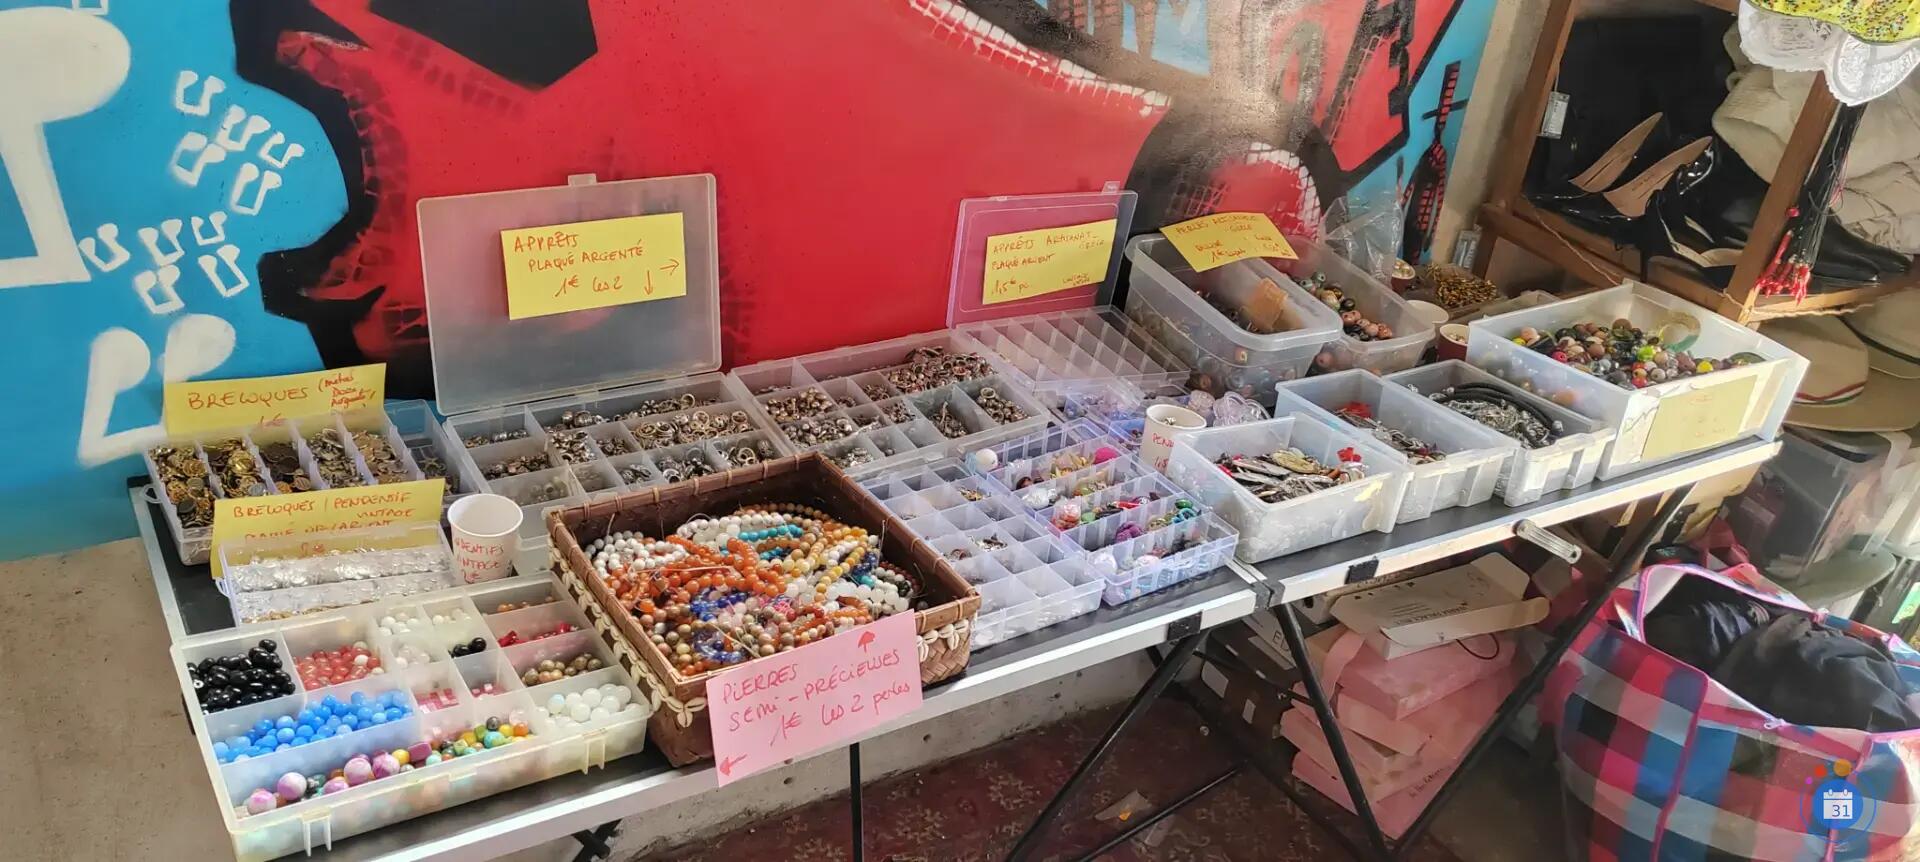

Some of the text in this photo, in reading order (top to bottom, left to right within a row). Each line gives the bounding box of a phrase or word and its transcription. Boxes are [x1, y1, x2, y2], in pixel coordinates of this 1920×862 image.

[528, 238, 644, 273] PLAQUÉ ARGENTÉ
[613, 275, 624, 290] 2
[187, 386, 309, 411] BRELOQUES
[723, 662, 799, 704] PIERRES
[850, 694, 865, 714] 2
[872, 680, 911, 716] perles
